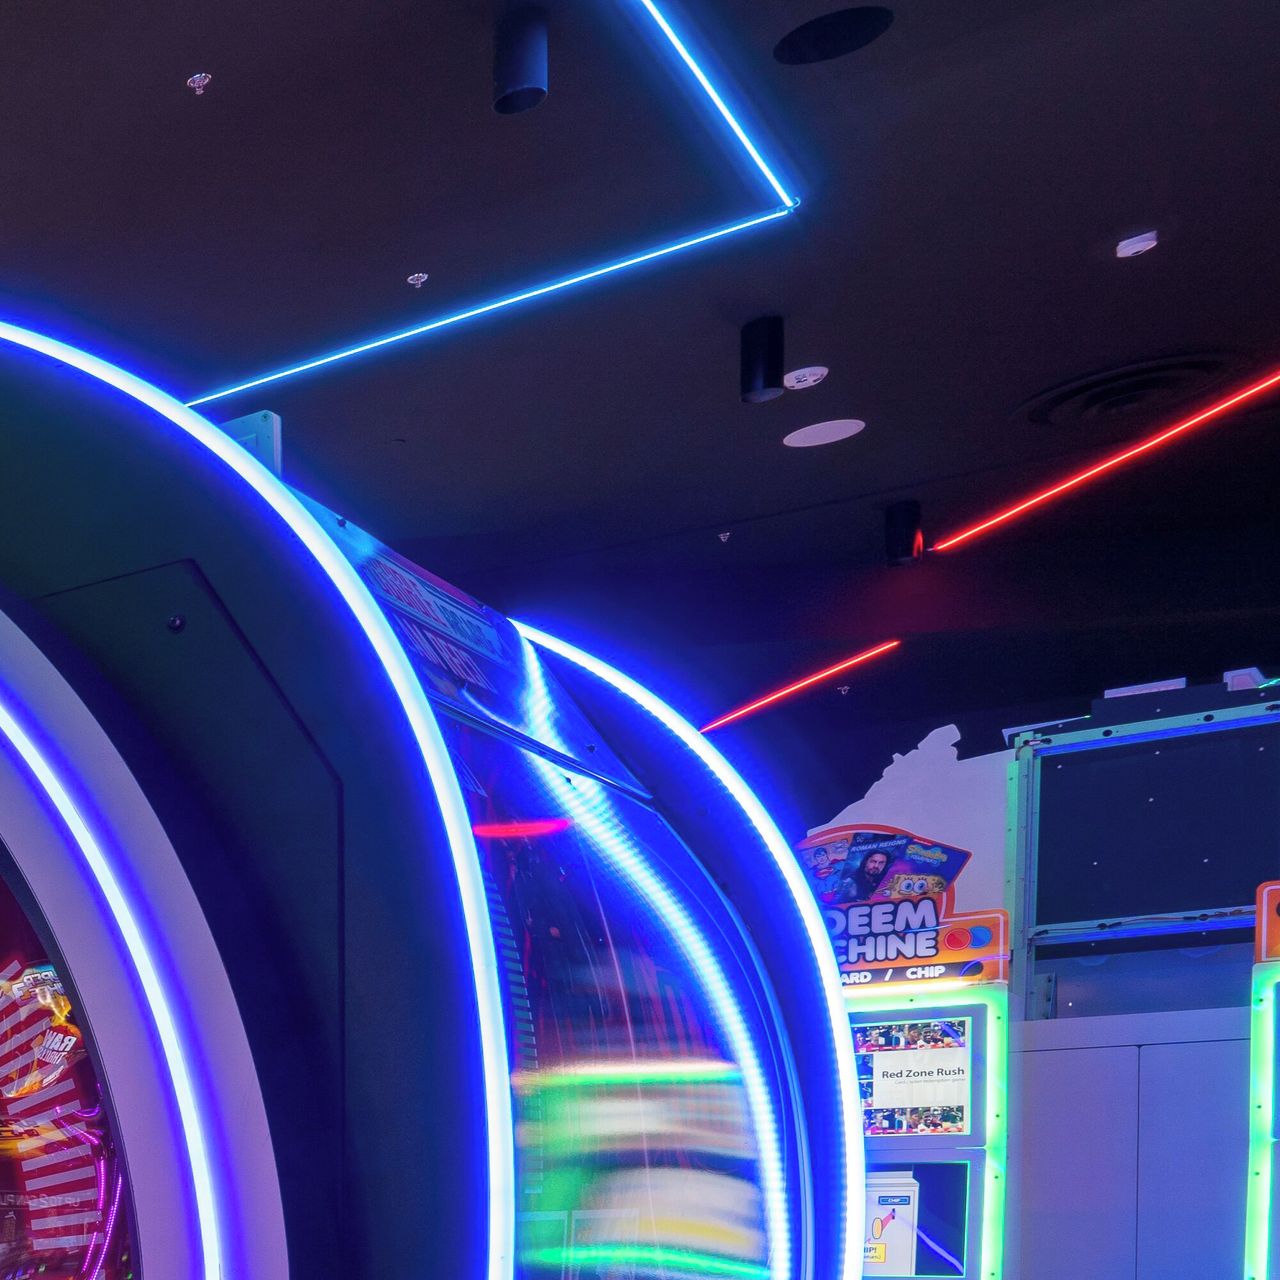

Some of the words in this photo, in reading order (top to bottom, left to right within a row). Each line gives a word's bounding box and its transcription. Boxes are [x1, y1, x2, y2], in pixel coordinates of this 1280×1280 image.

[841, 971, 872, 984] ARD
[906, 965, 946, 979] CHIP
[881, 1069, 903, 1079] Red
[905, 1069, 934, 1078] Zone
[936, 1067, 965, 1077] Rush
